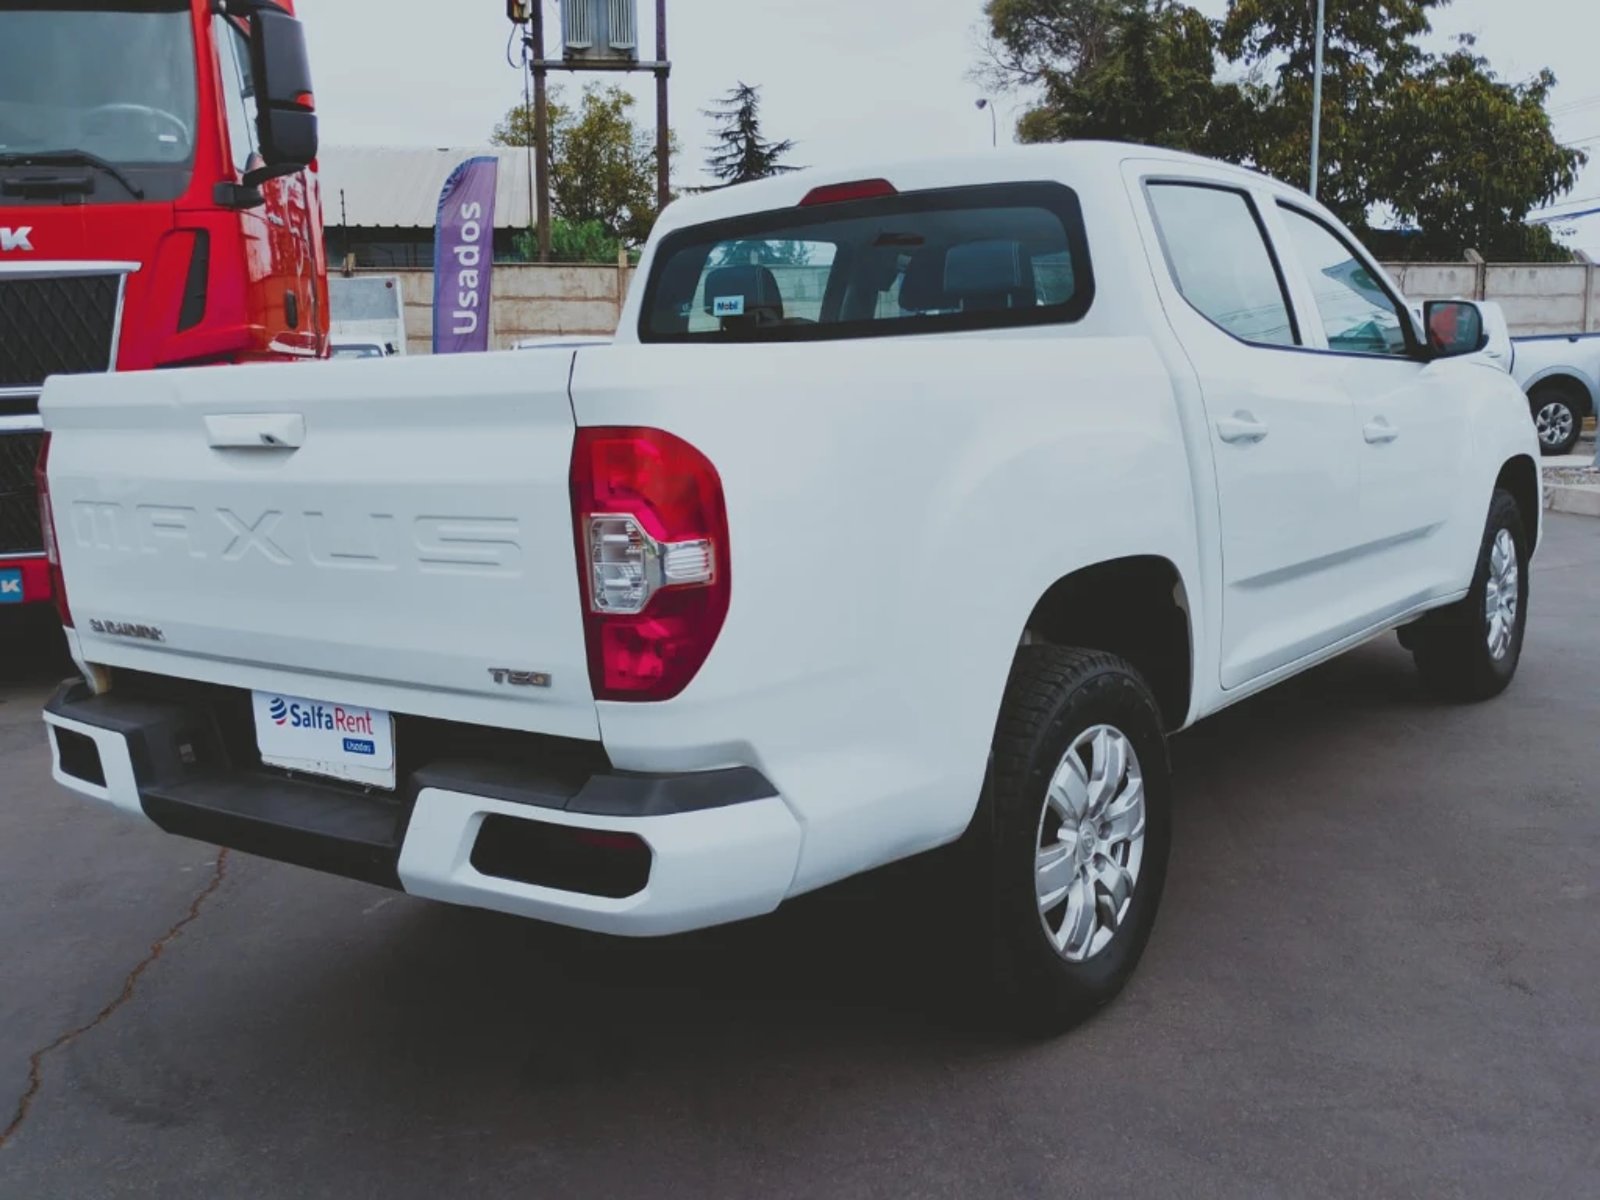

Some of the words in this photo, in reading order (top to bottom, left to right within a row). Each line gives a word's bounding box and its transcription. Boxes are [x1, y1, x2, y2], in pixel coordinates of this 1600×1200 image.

[452, 201, 481, 335] Usados
[717, 301, 738, 310] Mobil
[72, 500, 523, 577] MAXUS
[290, 703, 374, 735] SalfaRent
